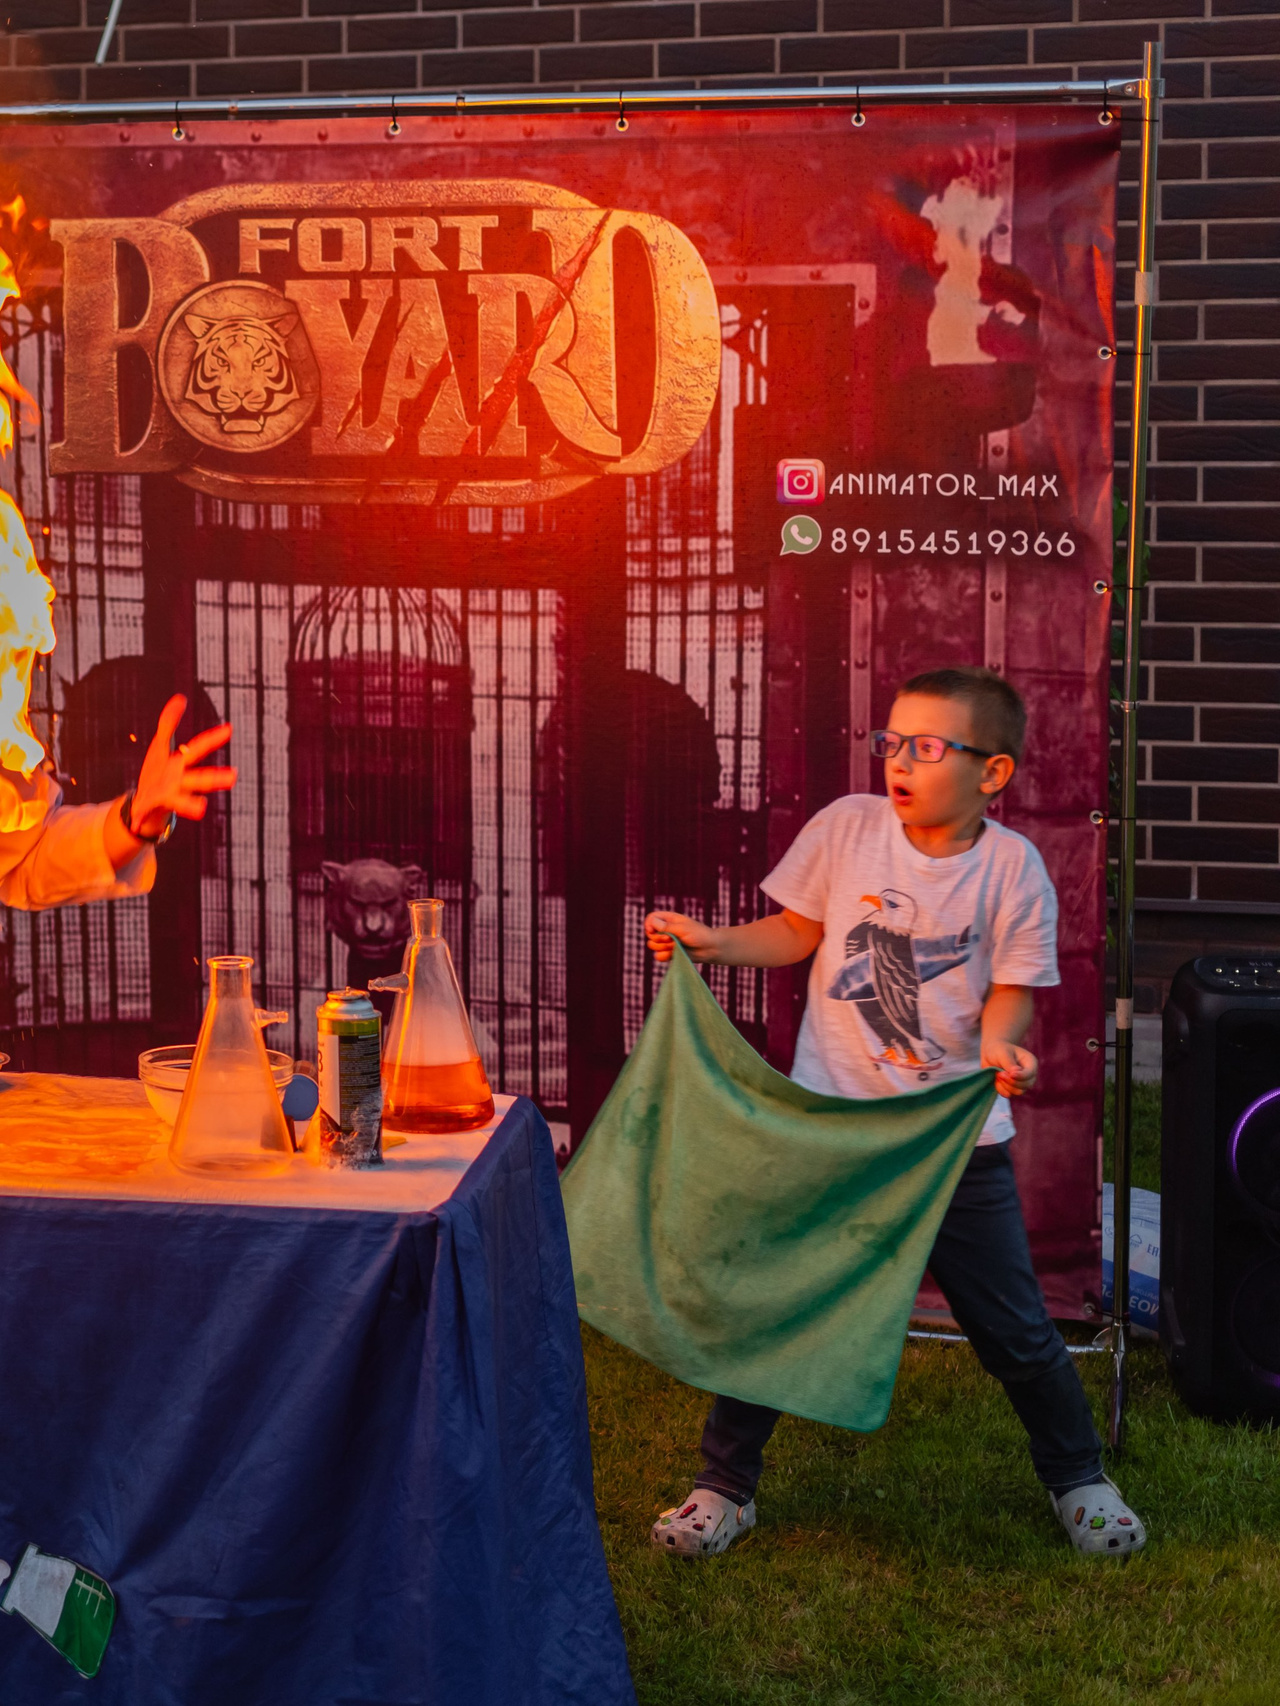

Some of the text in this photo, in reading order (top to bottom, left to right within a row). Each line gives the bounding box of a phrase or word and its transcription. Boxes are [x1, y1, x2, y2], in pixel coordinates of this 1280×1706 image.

[237, 214, 500, 273] FORT
[828, 473, 1059, 501] ANIMATOR_MAX
[830, 528, 1076, 557] 89154519366
